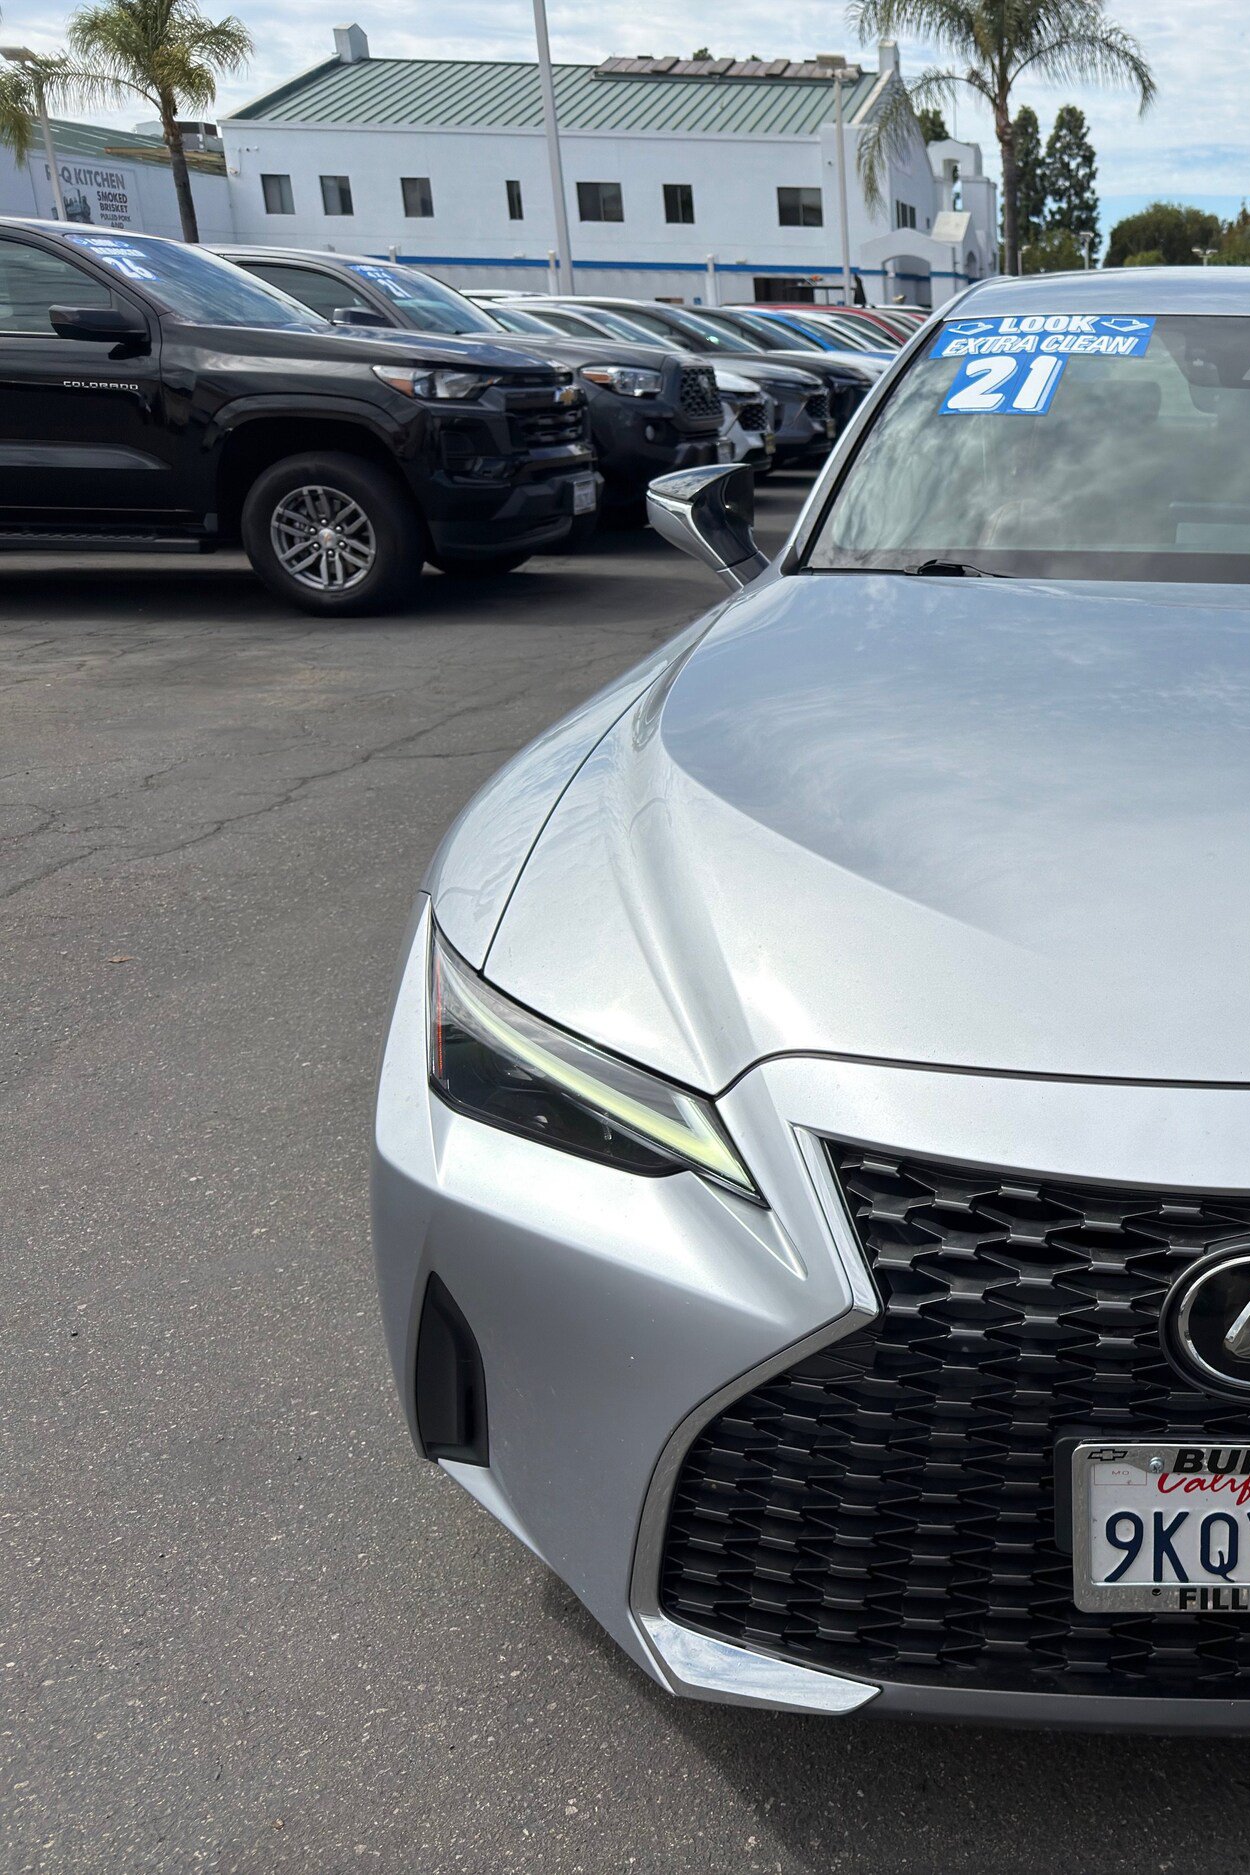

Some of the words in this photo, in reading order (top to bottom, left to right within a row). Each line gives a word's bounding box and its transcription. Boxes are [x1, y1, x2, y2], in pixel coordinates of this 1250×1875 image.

[74, 167, 126, 190] KITCHEN
[96, 190, 128, 204] SMOKED
[99, 202, 128, 213] BRISKET
[998, 315, 1101, 335] LOOK
[941, 335, 1038, 358] EXTRA
[1040, 334, 1139, 355] CLEAN
[63, 381, 139, 391] COLORADO
[947, 355, 1064, 413] 21
